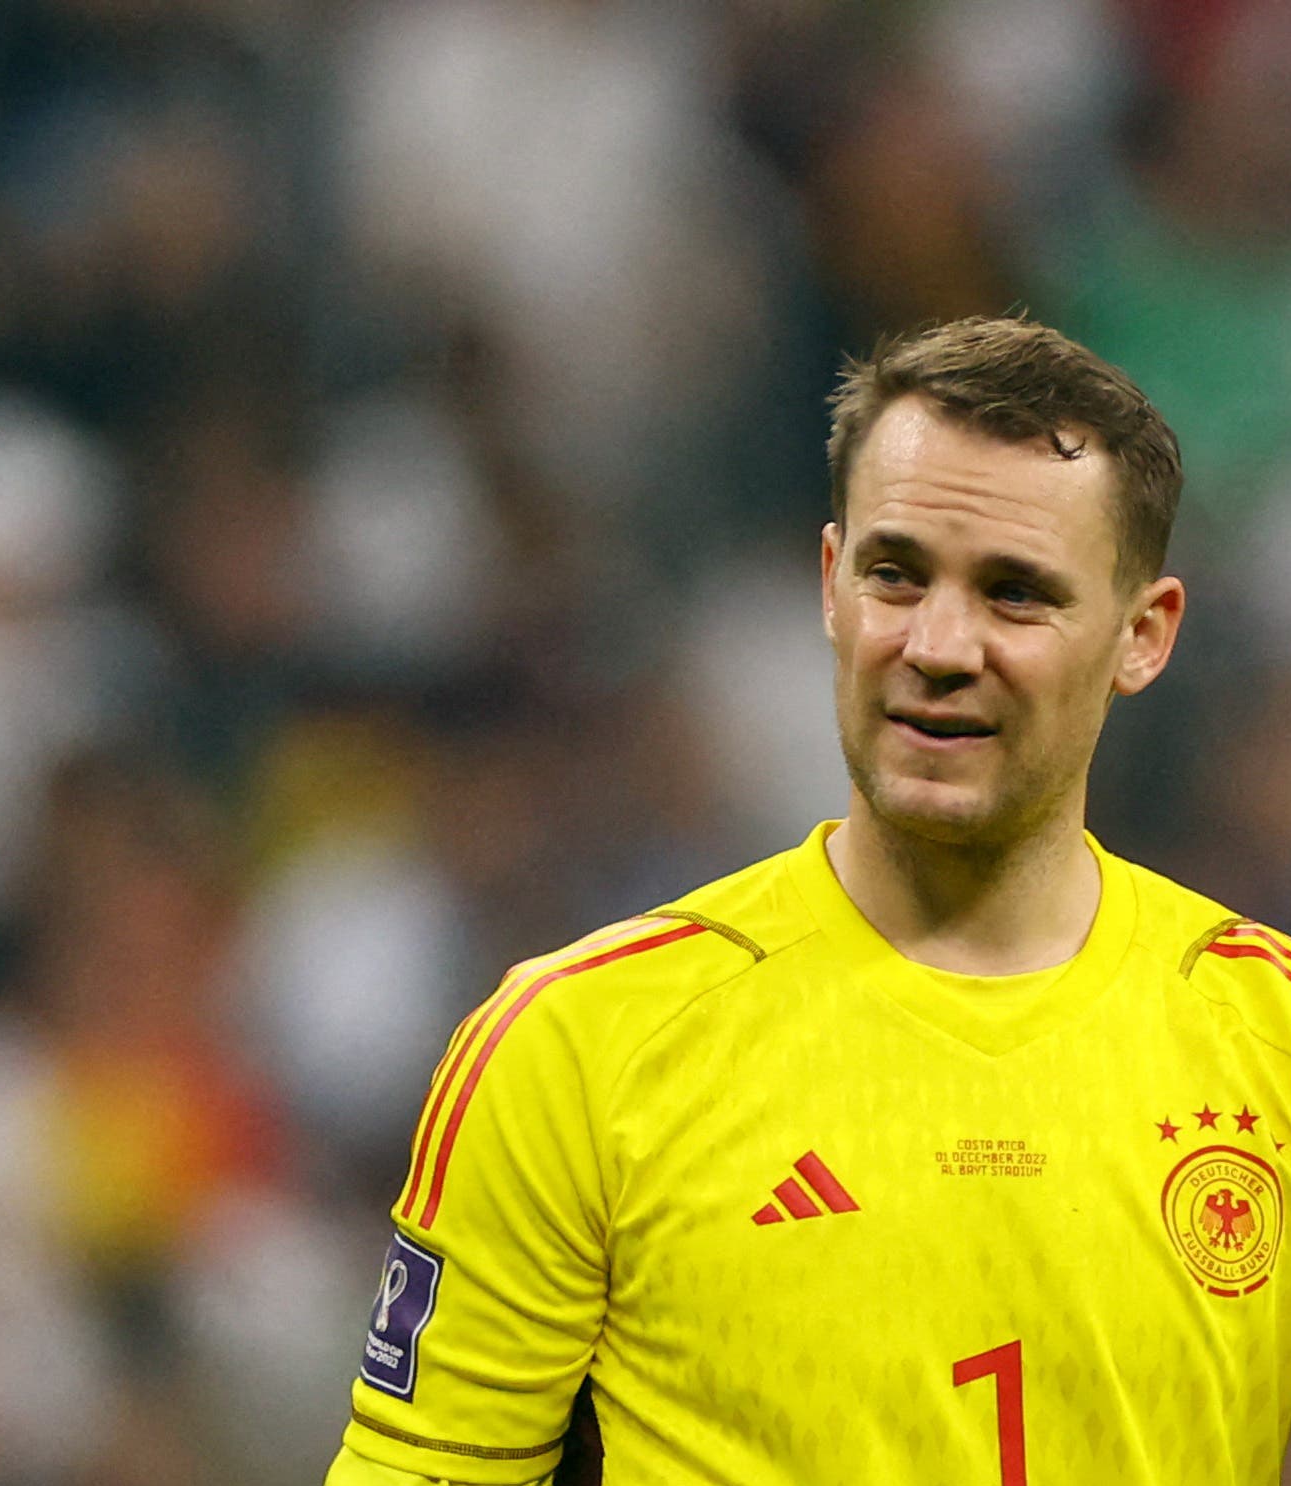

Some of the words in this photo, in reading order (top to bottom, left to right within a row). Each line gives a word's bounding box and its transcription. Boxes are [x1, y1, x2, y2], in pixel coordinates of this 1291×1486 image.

[957, 1139, 993, 1150] COSTA
[997, 1140, 1025, 1151] RICA
[935, 1152, 948, 1162] 01
[952, 1152, 1013, 1163] DECEMBER
[1017, 1153, 1047, 1165] 2022
[941, 1165, 955, 1176] AL
[959, 1165, 987, 1176] BAYT
[991, 1165, 1043, 1177] STADIUM
[1190, 1165, 1264, 1196] DEUTSCHER
[1182, 1232, 1270, 1277] FUSSBALL-BUND
